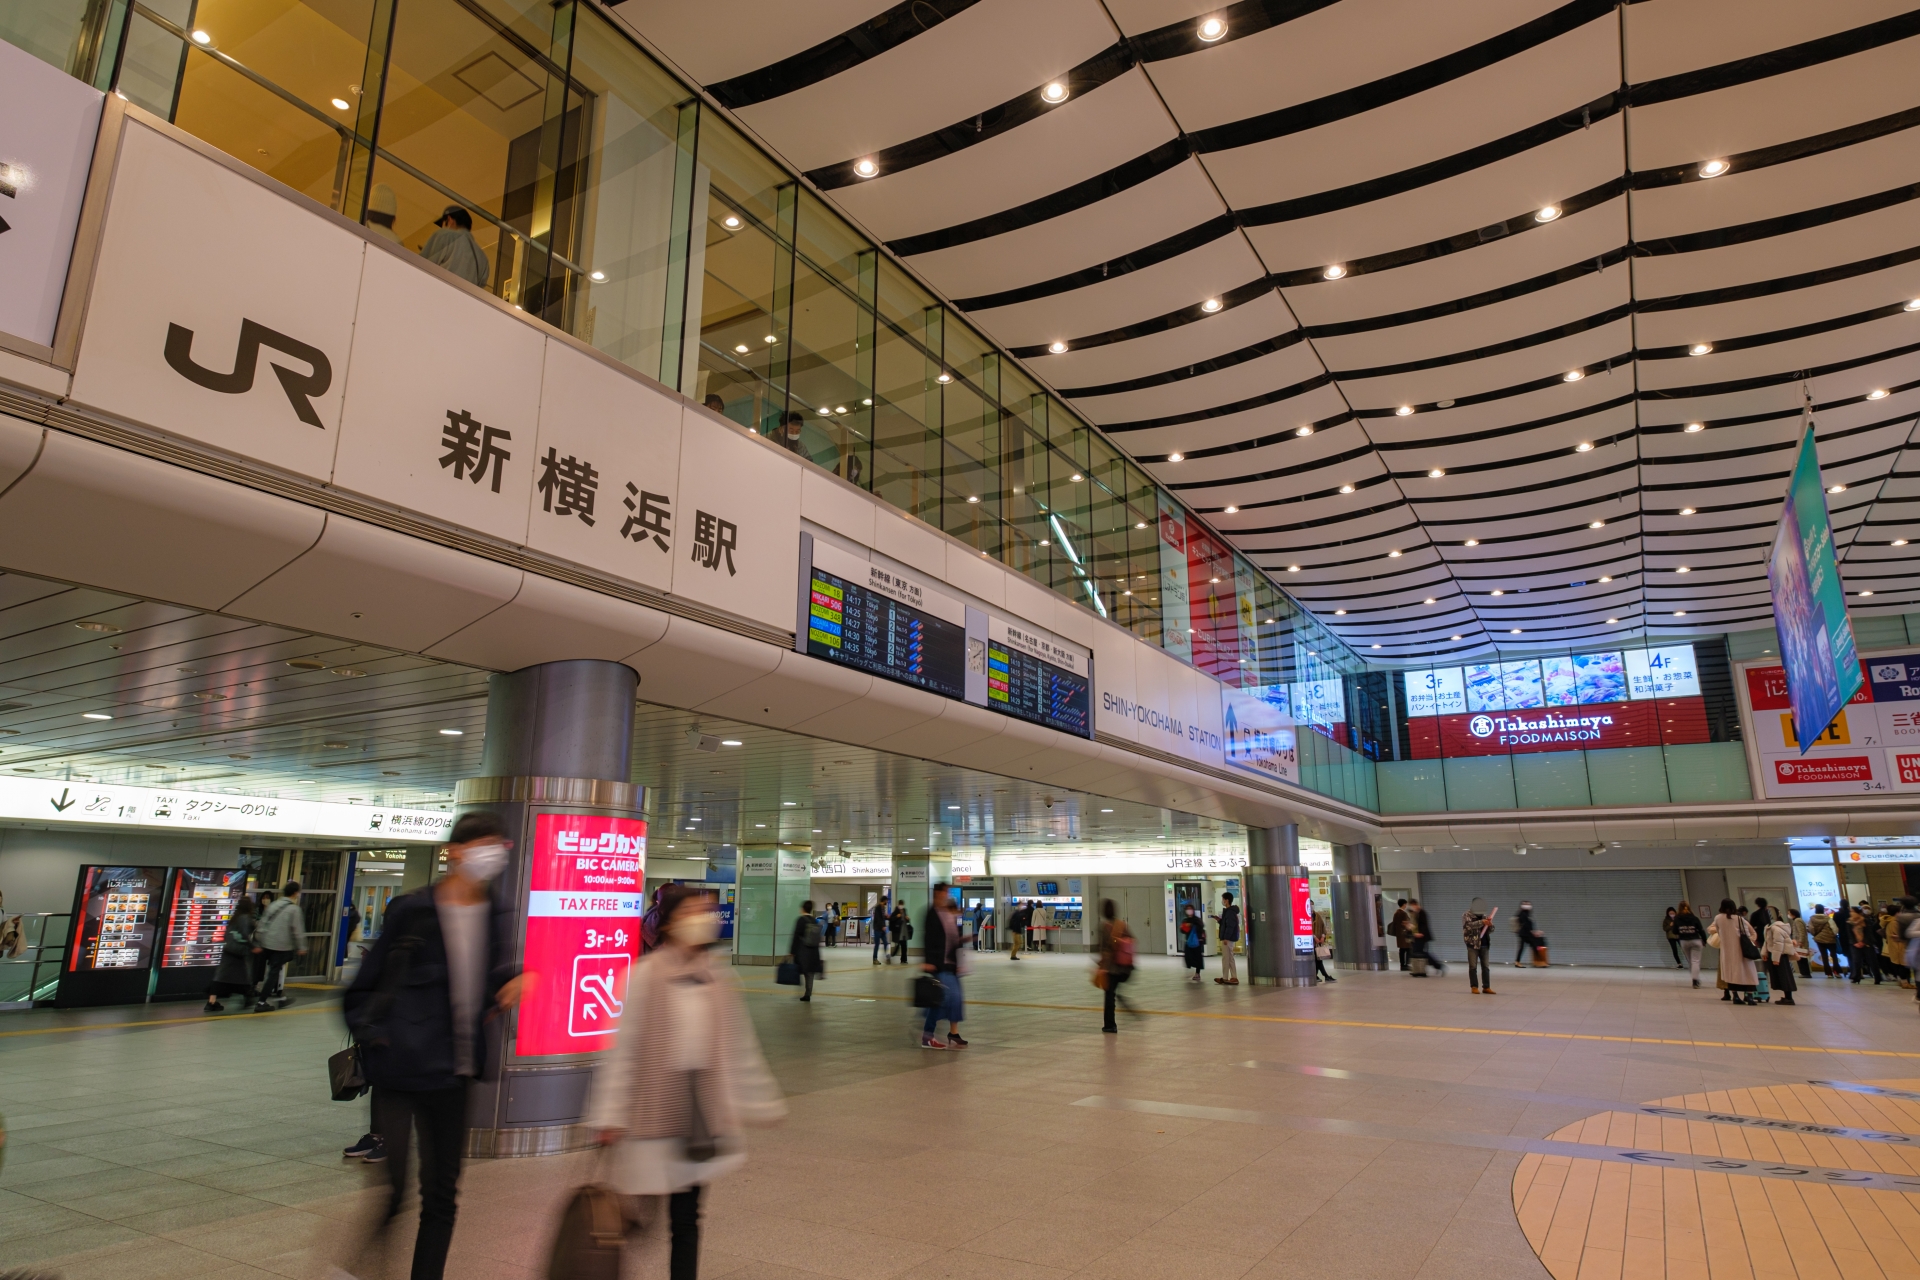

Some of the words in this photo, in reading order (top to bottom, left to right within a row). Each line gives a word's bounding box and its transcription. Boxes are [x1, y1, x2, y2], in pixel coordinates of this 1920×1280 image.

[165, 317, 333, 430] JR
[438, 409, 738, 586] 新横浜駅
[870, 567, 891, 585] 新幹線
[868, 578, 897, 596] Shinkansen
[898, 590, 908, 601] (for
[833, 588, 841, 598] 18
[846, 594, 861, 607] 14:17
[831, 600, 842, 610] 506
[845, 605, 860, 618] 14:25
[830, 612, 841, 622] 348
[845, 617, 860, 629] 14:27
[829, 623, 841, 634] 720
[845, 629, 860, 642] 14:30
[1007, 626, 1022, 641] 新幹線
[829, 636, 840, 646] 106
[844, 641, 859, 655] 14:35
[1650, 652, 1671, 669] 4F
[1425, 674, 1443, 689] 3F
[1633, 671, 1693, 684] 生鮮・お惣菜
[1634, 683, 1674, 693] 和洋菓子
[1103, 691, 1184, 738] SHIN-YOKOHAMA
[1188, 725, 1222, 752] STATION
[1495, 715, 1613, 732] Takashimaya
[1500, 730, 1600, 745] FOODMAISON
[1256, 754, 1278, 773] Yokohama
[1278, 762, 1287, 777] Line
[1794, 763, 1867, 774] Takashimaya
[1798, 773, 1860, 781] FOODMAISON
[157, 796, 178, 804] TAXI
[186, 799, 279, 817] タクシーのりば
[182, 812, 201, 821] Taxi
[388, 826, 422, 835] Yokohama
[576, 858, 598, 870] BIC
[601, 860, 639, 872] CAMERA
[852, 866, 890, 874] Shinkansen
[1167, 858, 1204, 868] JR全線
[1322, 859, 1331, 867] JR
[558, 898, 588, 910] TAX
[591, 898, 618, 910] FREE
[623, 901, 633, 909] VISA
